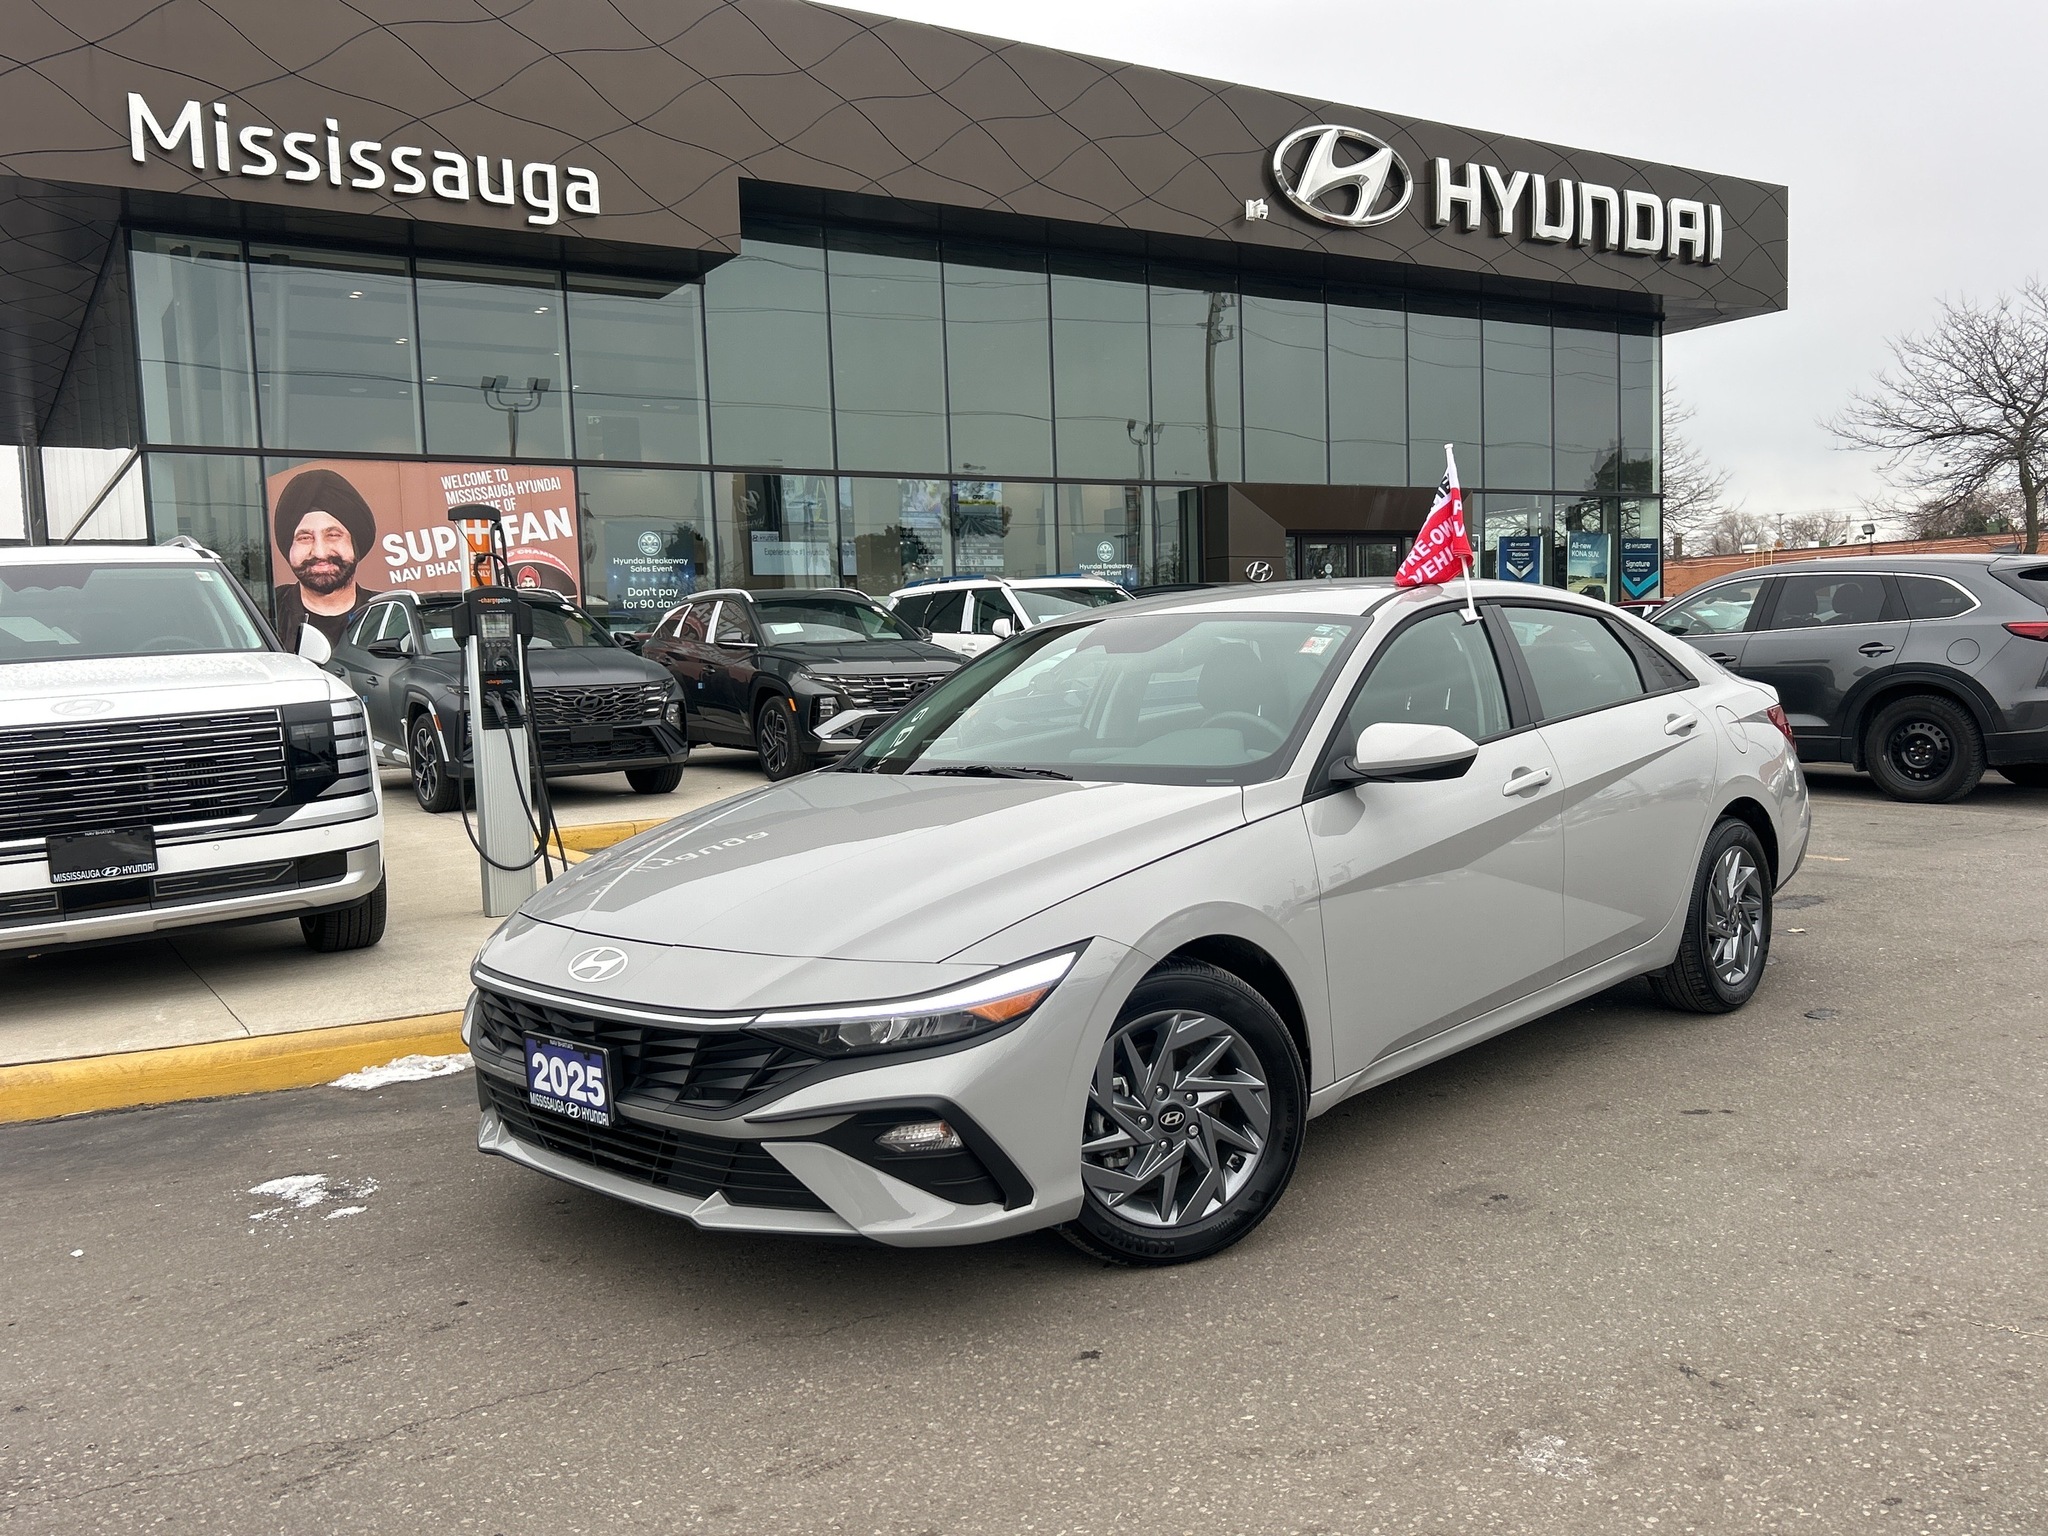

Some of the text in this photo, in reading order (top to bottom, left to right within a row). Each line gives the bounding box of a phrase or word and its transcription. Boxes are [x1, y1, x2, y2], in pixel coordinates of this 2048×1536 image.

[127, 92, 600, 225] Mississauga
[1430, 156, 1722, 266] HYUNDAI
[440, 468, 508, 490] WELCOME TO
[446, 476, 562, 505] MISSISSAUGA HYUNDAI
[504, 498, 516, 512] OF
[382, 507, 574, 566] SUPFAN
[1398, 516, 1454, 576] PRE-OW
[389, 560, 462, 584] NAV BHAT
[1408, 546, 1454, 584] VEHI
[1626, 560, 1650, 568] Signature
[623, 600, 638, 609] for
[640, 600, 654, 609] 90
[628, 587, 678, 598] Don't pay
[53, 862, 156, 882] MISSISSAUGA HYUNDAI
[532, 1052, 605, 1106] 2025
[530, 1092, 610, 1126] MISSISSAUGA HYUNDAI
[1097, 1222, 1176, 1254] KUMHO
